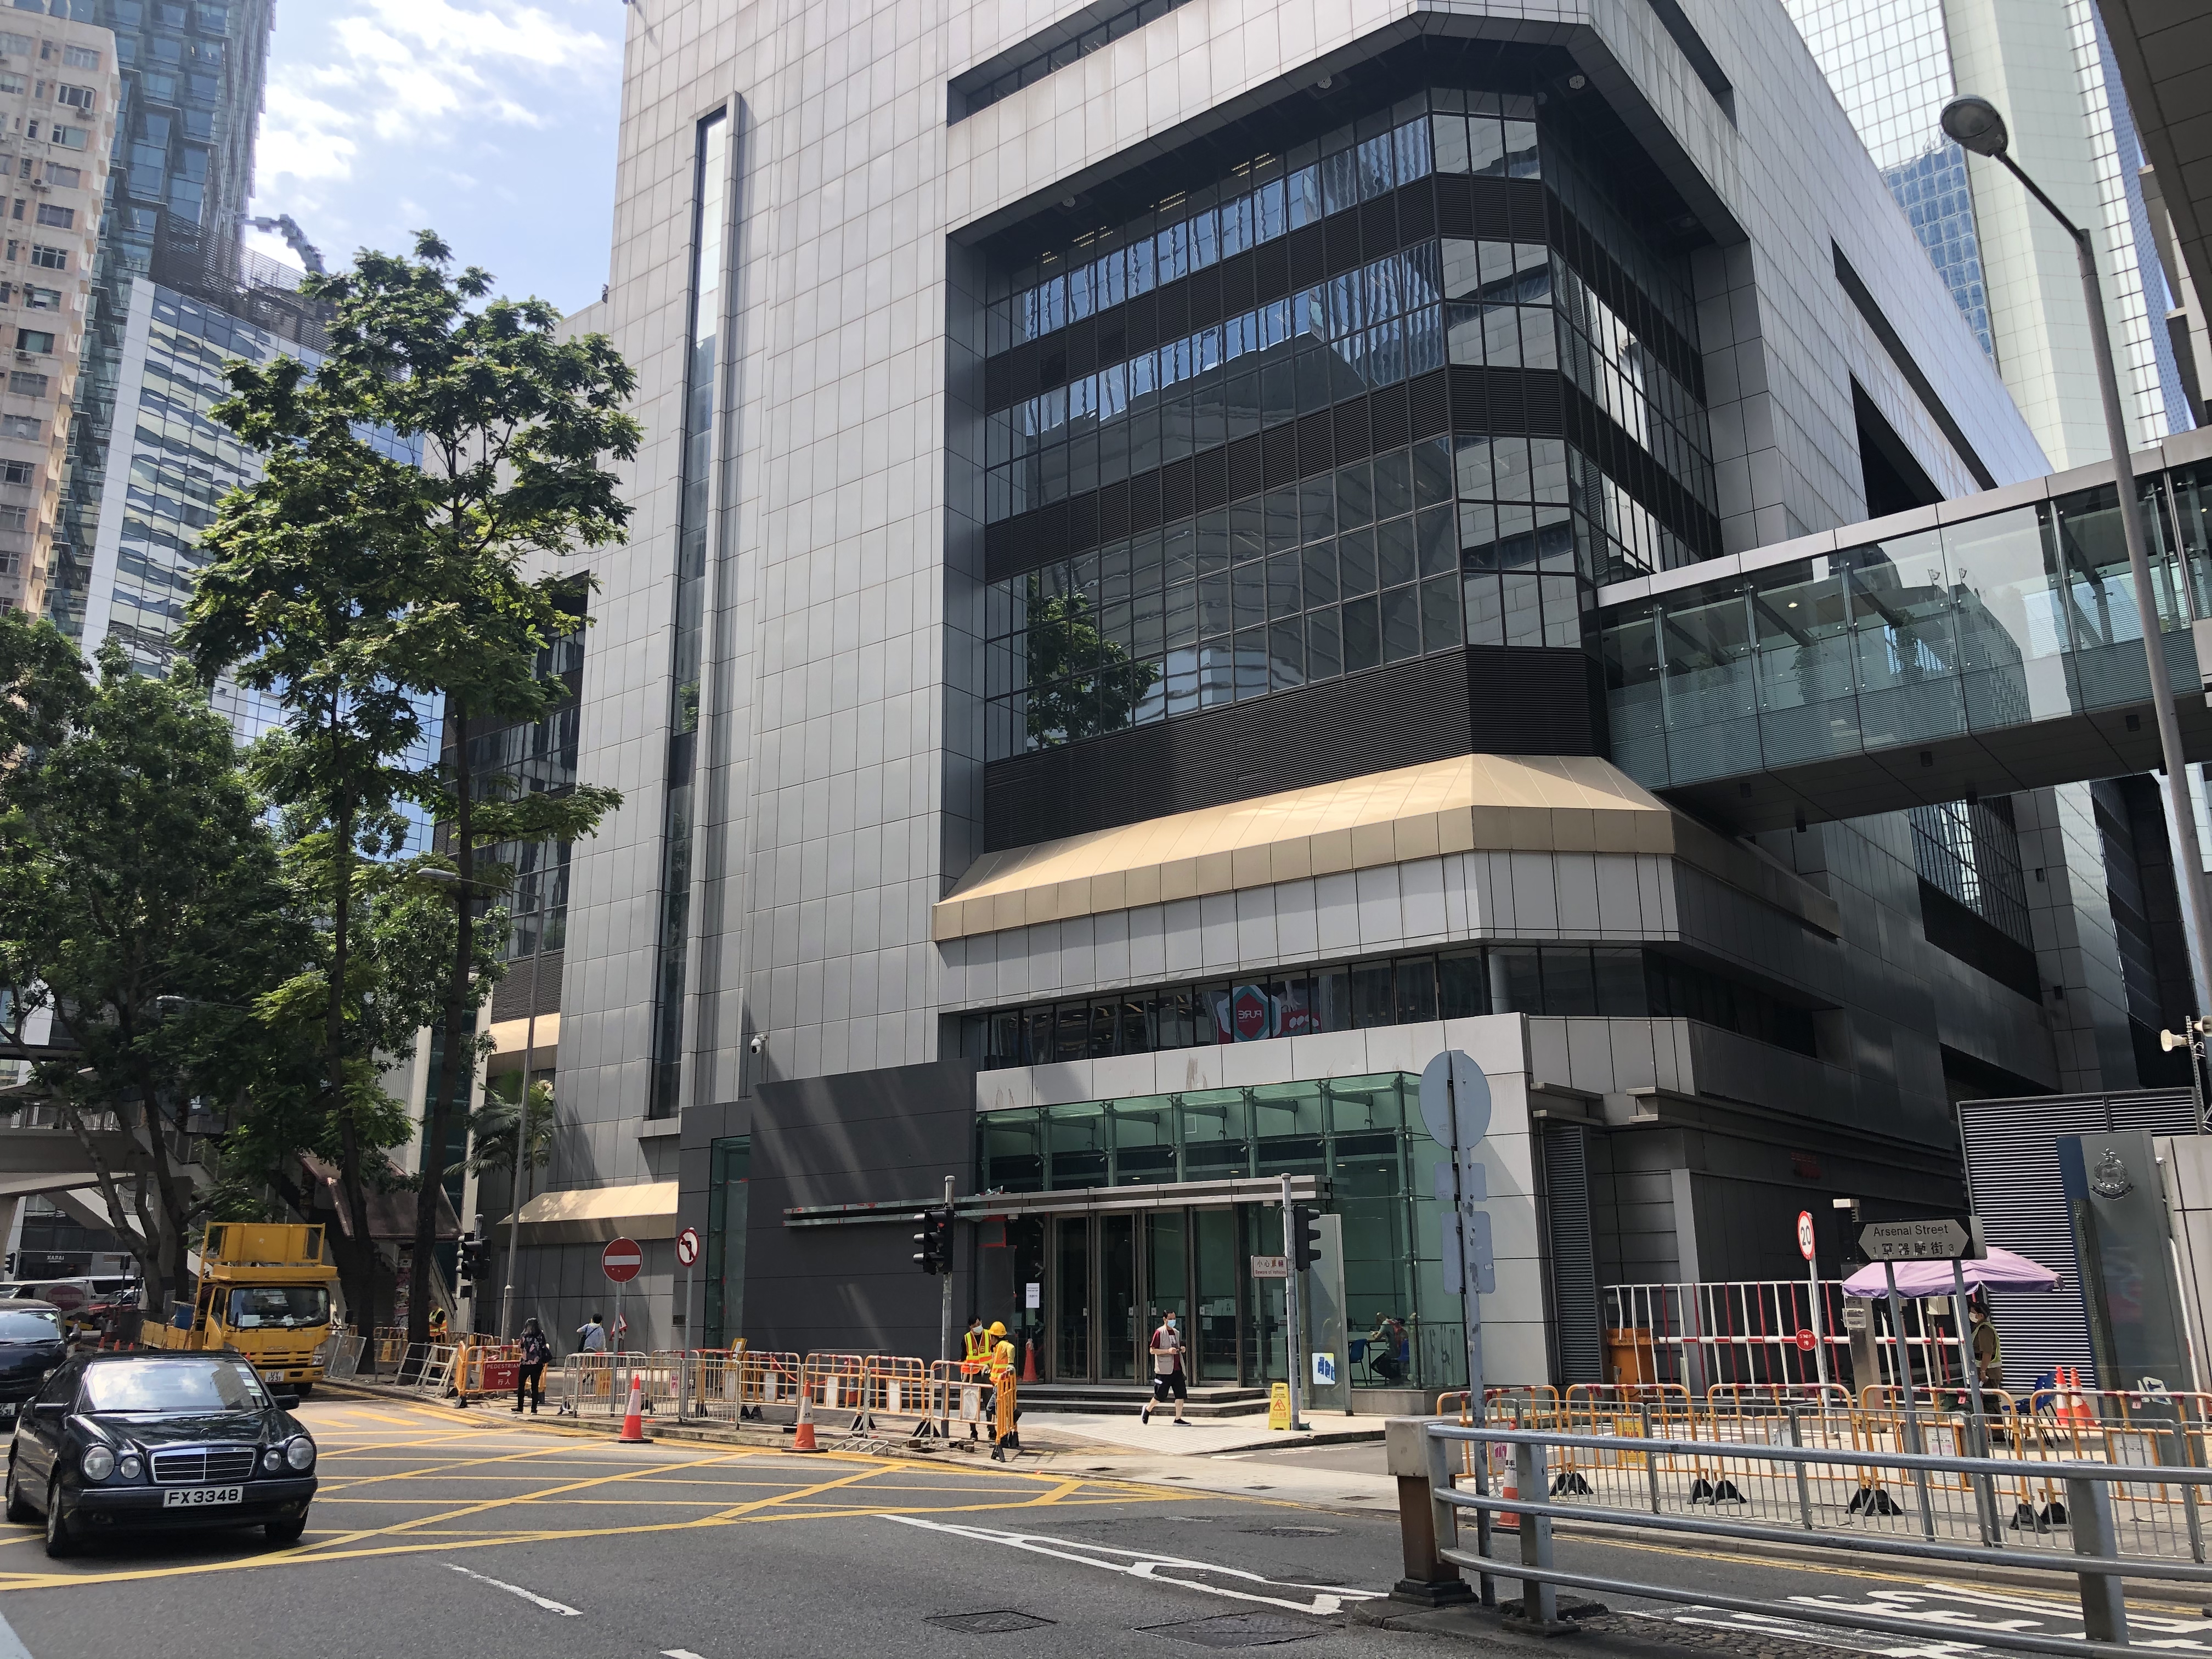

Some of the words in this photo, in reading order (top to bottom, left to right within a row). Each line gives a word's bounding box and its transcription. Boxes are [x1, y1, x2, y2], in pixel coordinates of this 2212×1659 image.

[1801, 1224, 1812, 1246] 20
[1873, 1226, 1912, 1237] Arsenal
[1915, 1224, 1949, 1235] Street
[1949, 1243, 1955, 1251] 3
